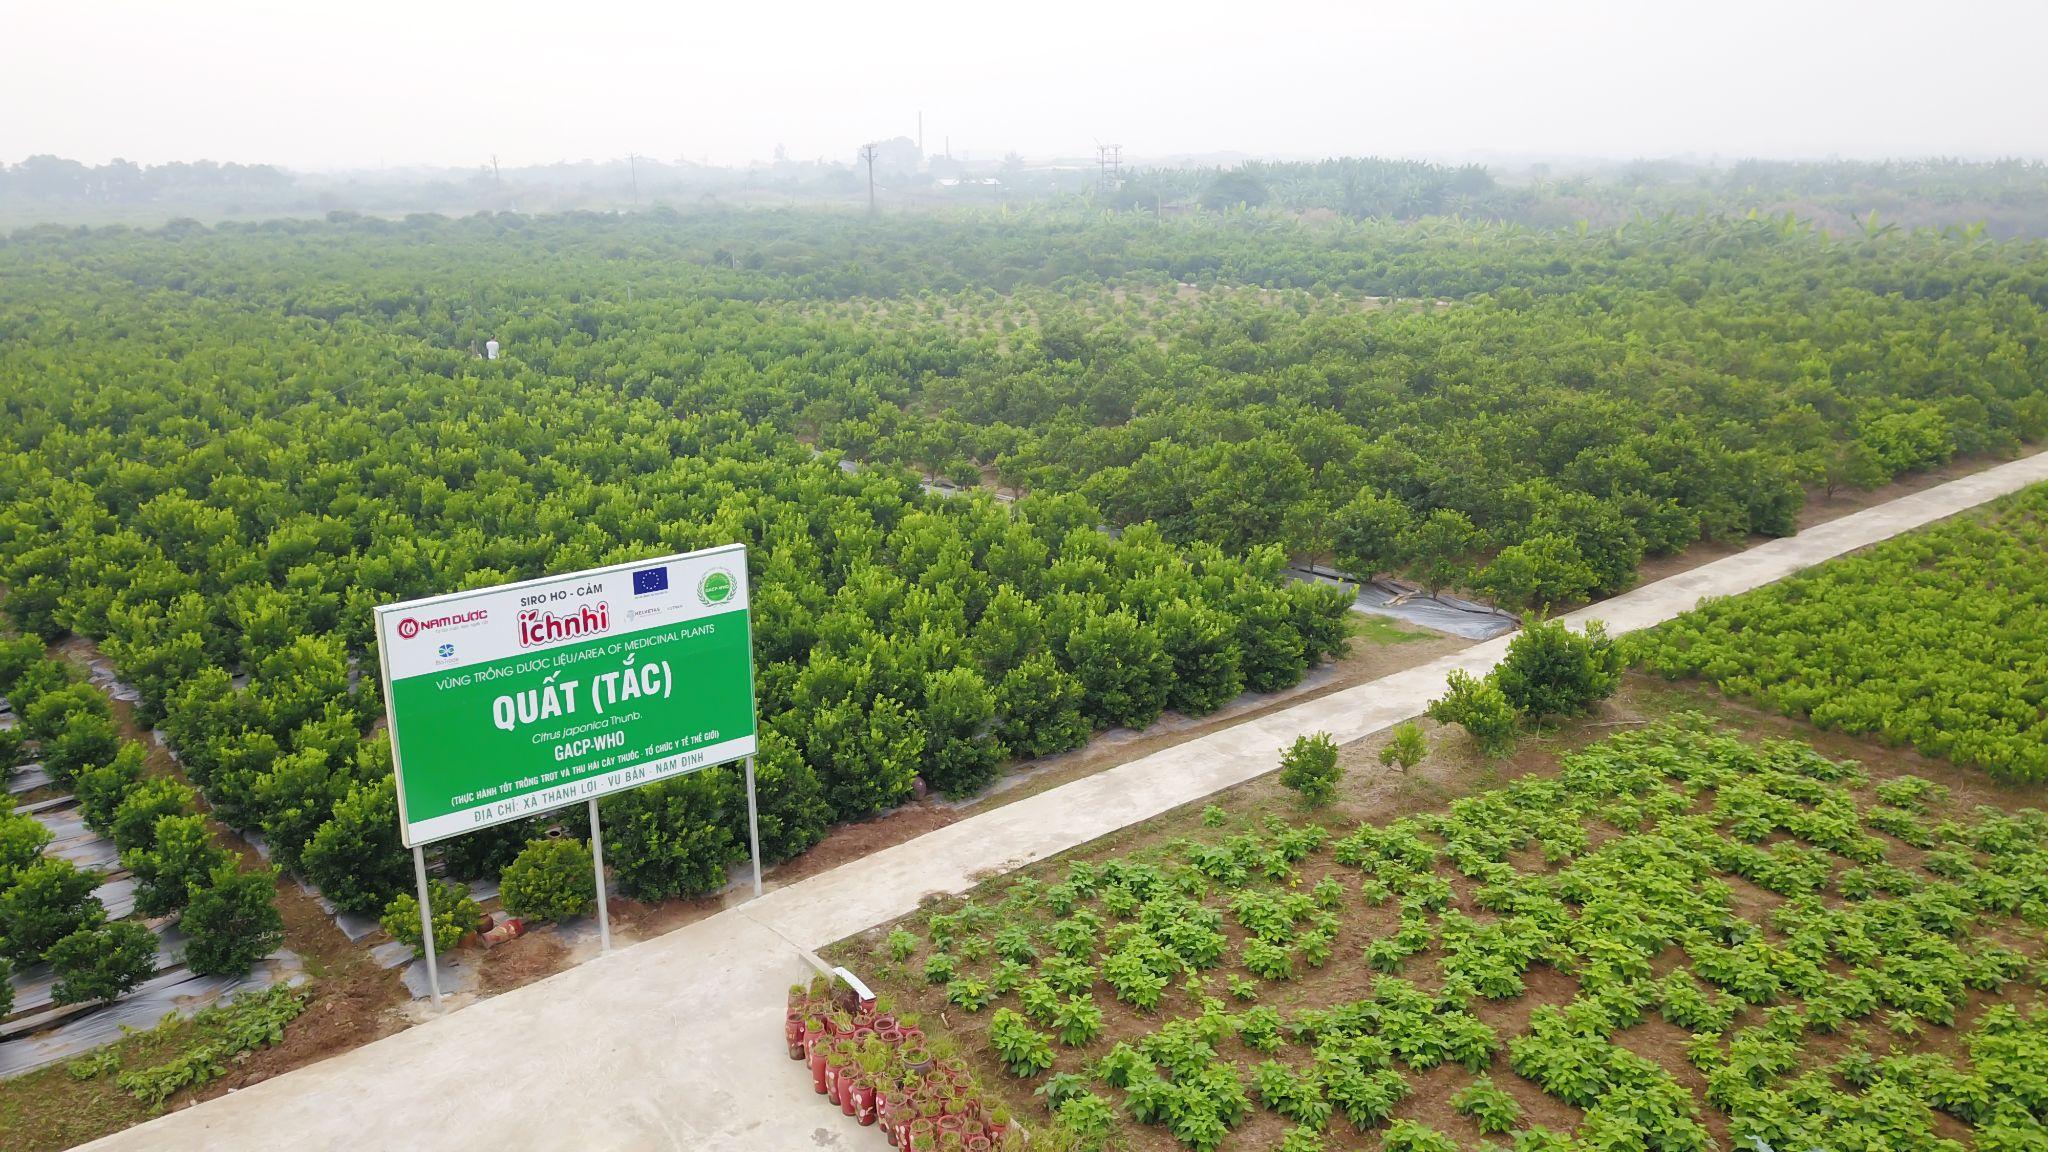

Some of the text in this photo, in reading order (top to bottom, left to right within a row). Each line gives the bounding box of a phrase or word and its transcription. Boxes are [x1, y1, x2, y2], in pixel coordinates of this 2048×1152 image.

[520, 594, 546, 607] SIRO
[550, 590, 567, 602] HO
[421, 616, 451, 631] NAM
[435, 674, 472, 691] VÙNG
[607, 643, 622, 655] OF
[624, 632, 679, 651] MEDICINAL
[680, 624, 715, 640] PLANTS
[492, 652, 672, 732] QUẤT (TẮC)
[532, 711, 643, 744] Citrus japonica Thunb.
[554, 730, 625, 761] GACP-WHO
[572, 763, 586, 775] THU
[674, 740, 679, 748] Y
[655, 759, 677, 774] NAM
